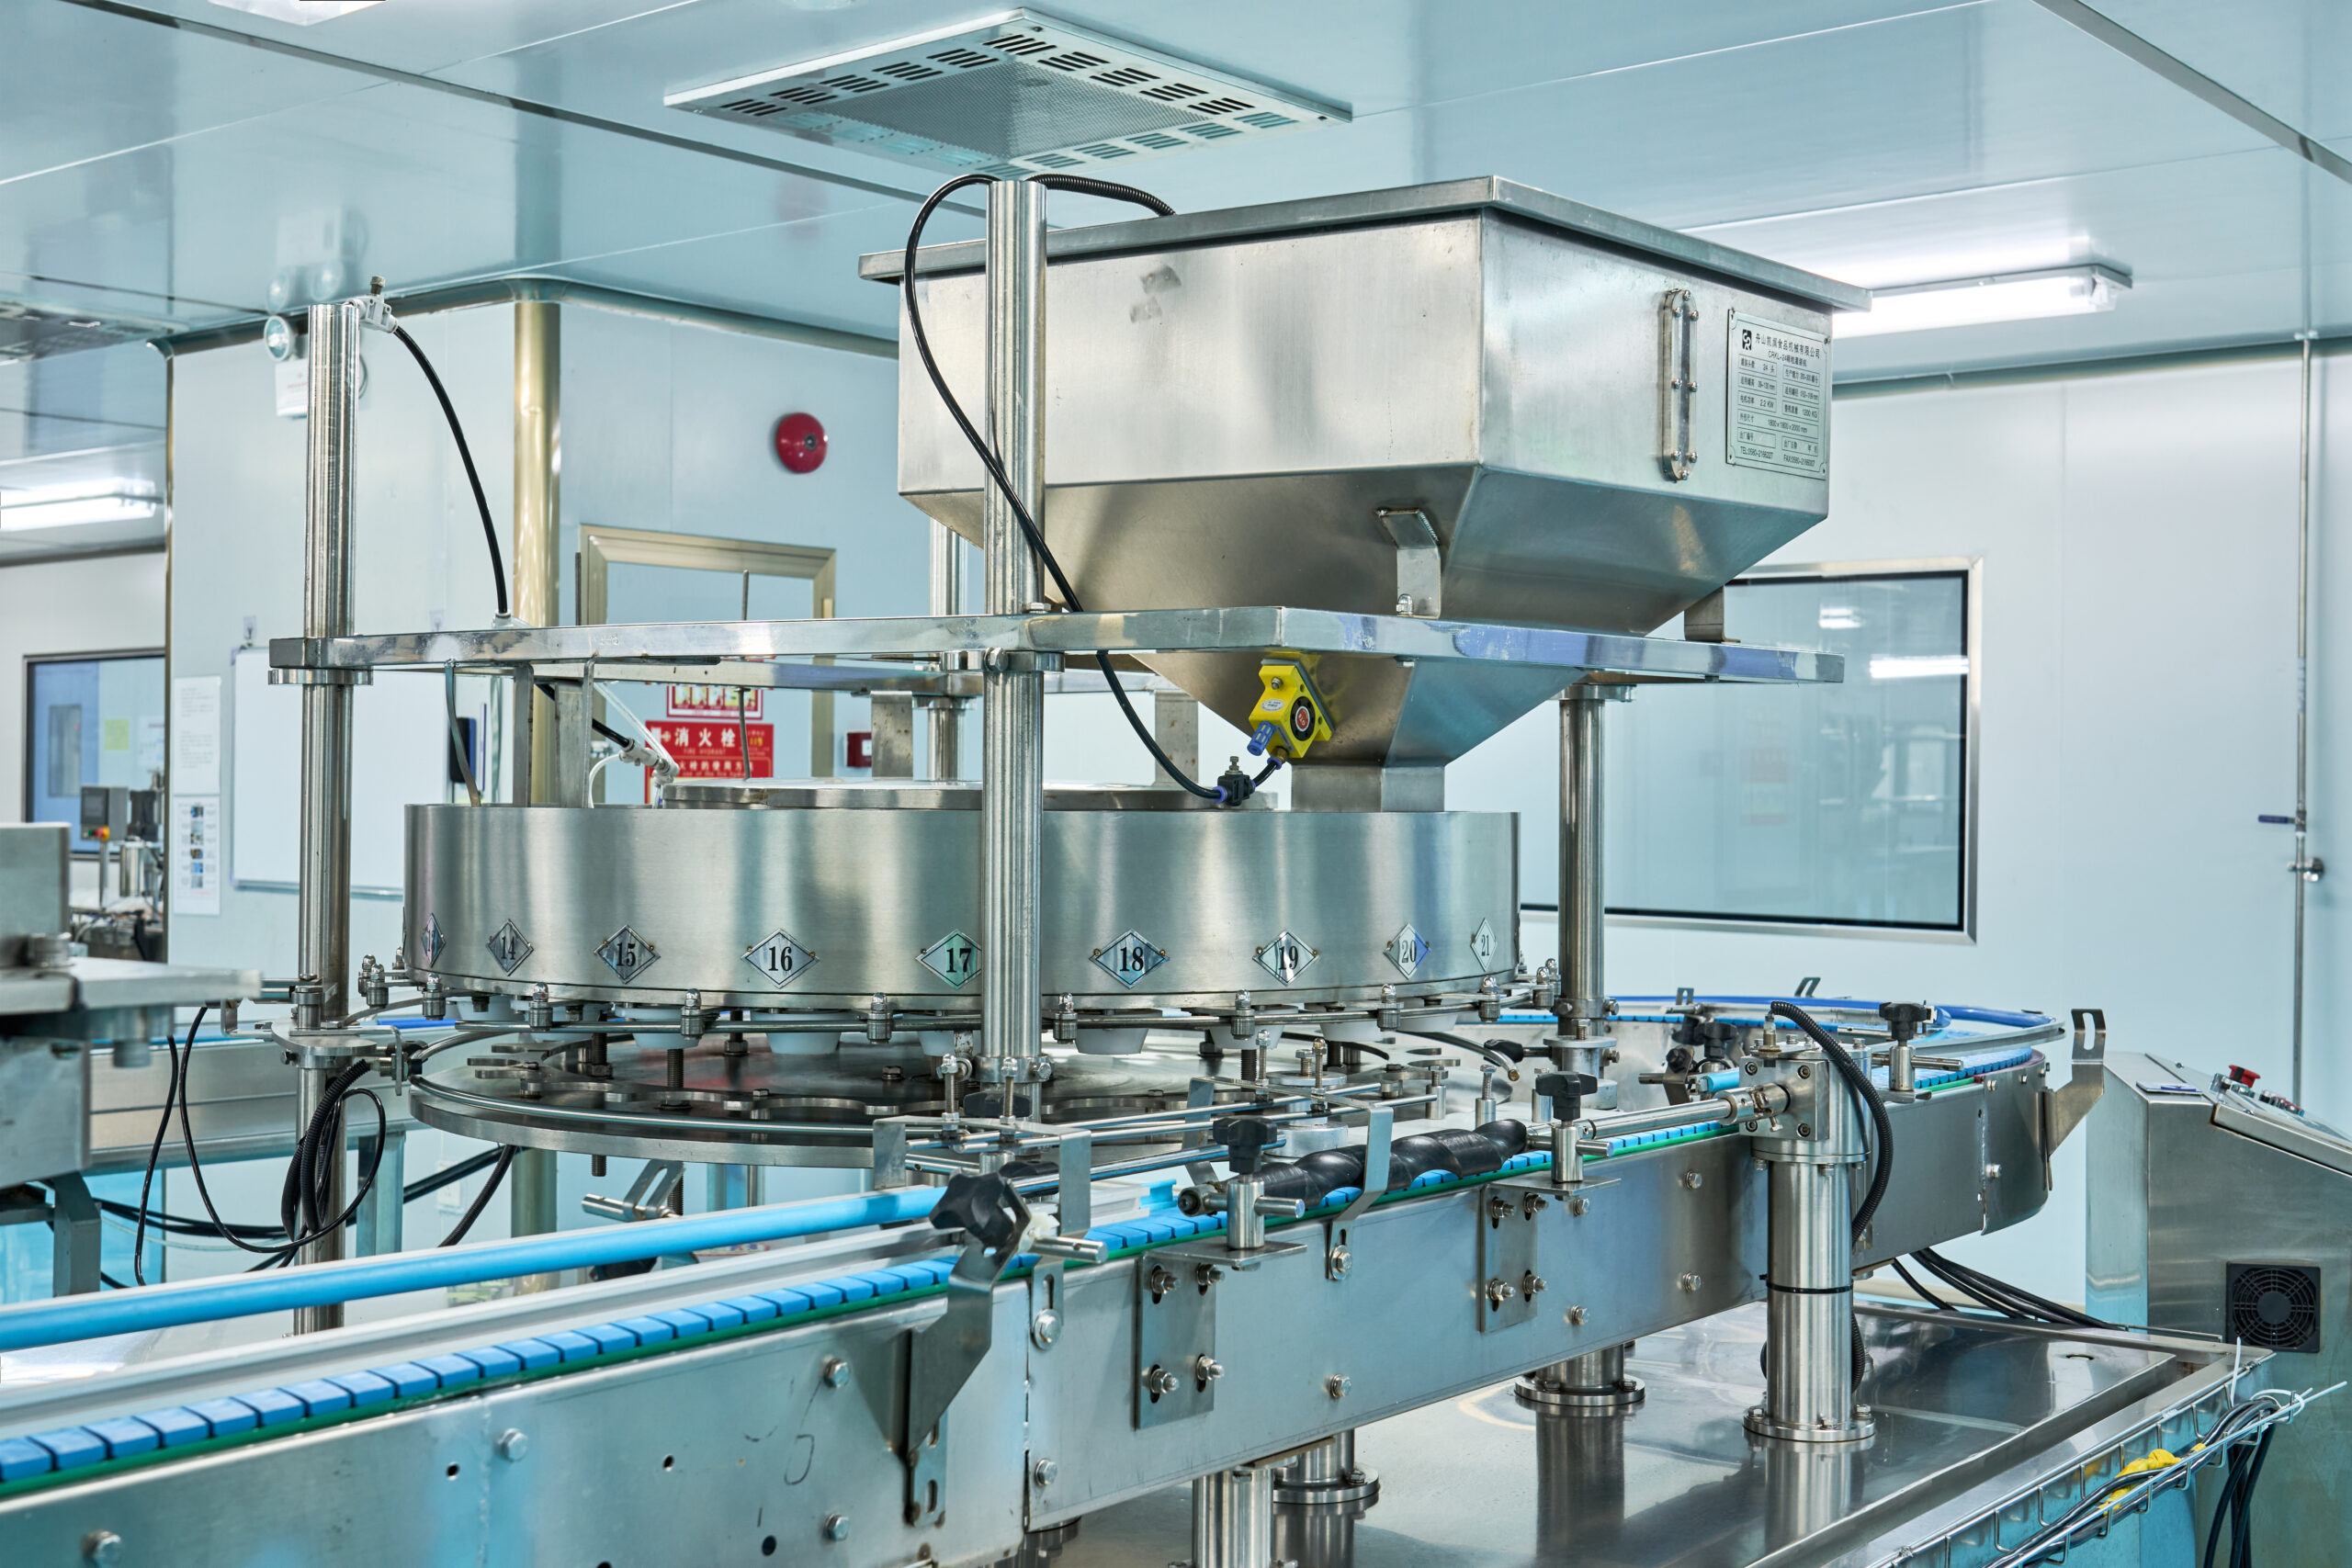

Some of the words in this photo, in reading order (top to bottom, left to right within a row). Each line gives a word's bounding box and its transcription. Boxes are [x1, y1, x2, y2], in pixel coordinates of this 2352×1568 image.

[501, 936, 515, 960] 14
[616, 942, 636, 967] 15
[1278, 945, 1298, 970] 19
[1401, 940, 1418, 963] 20
[1481, 934, 1489, 957] 21
[768, 946, 793, 972] 16
[945, 947, 972, 973] 17
[1119, 946, 1145, 972] 18
